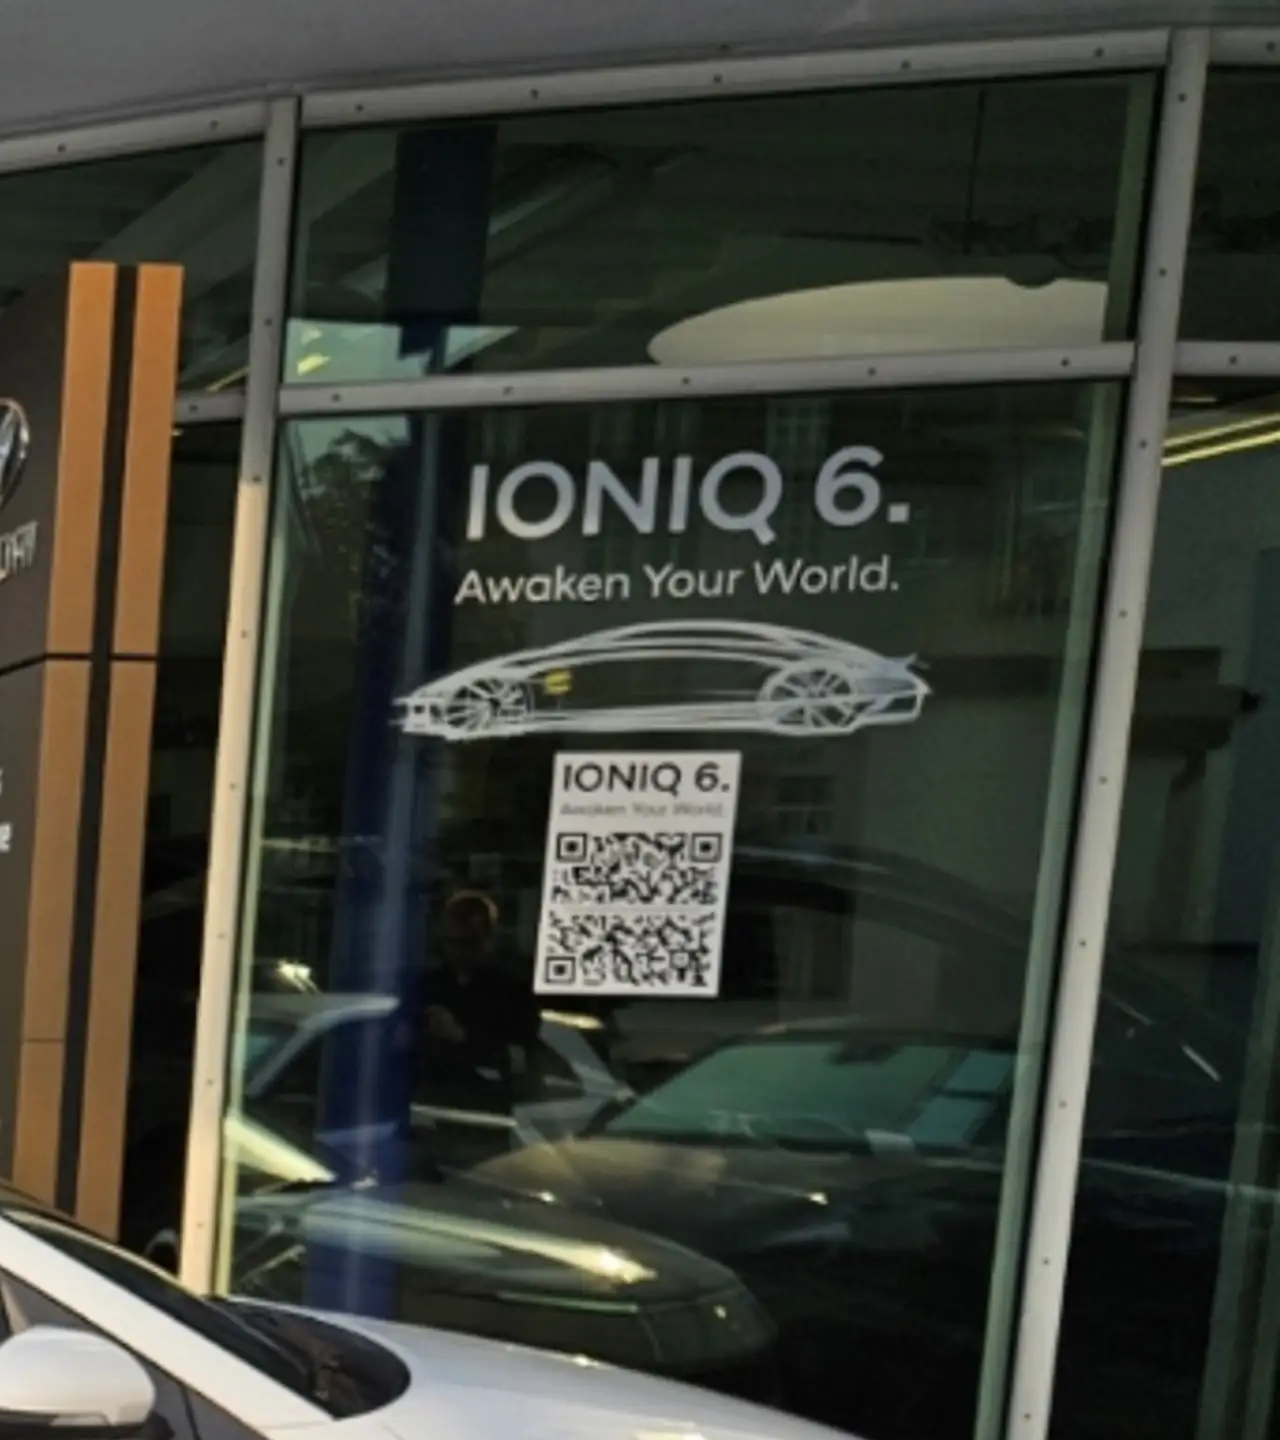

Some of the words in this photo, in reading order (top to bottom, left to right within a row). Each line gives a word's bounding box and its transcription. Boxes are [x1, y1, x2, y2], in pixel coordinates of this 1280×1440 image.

[466, 453, 783, 545] IONIQ
[814, 445, 910, 527] 6.
[452, 563, 631, 605] Awaken
[643, 559, 744, 598] Your
[753, 553, 900, 595] World.
[562, 762, 682, 796] IONIQ
[694, 761, 731, 793] 6.
